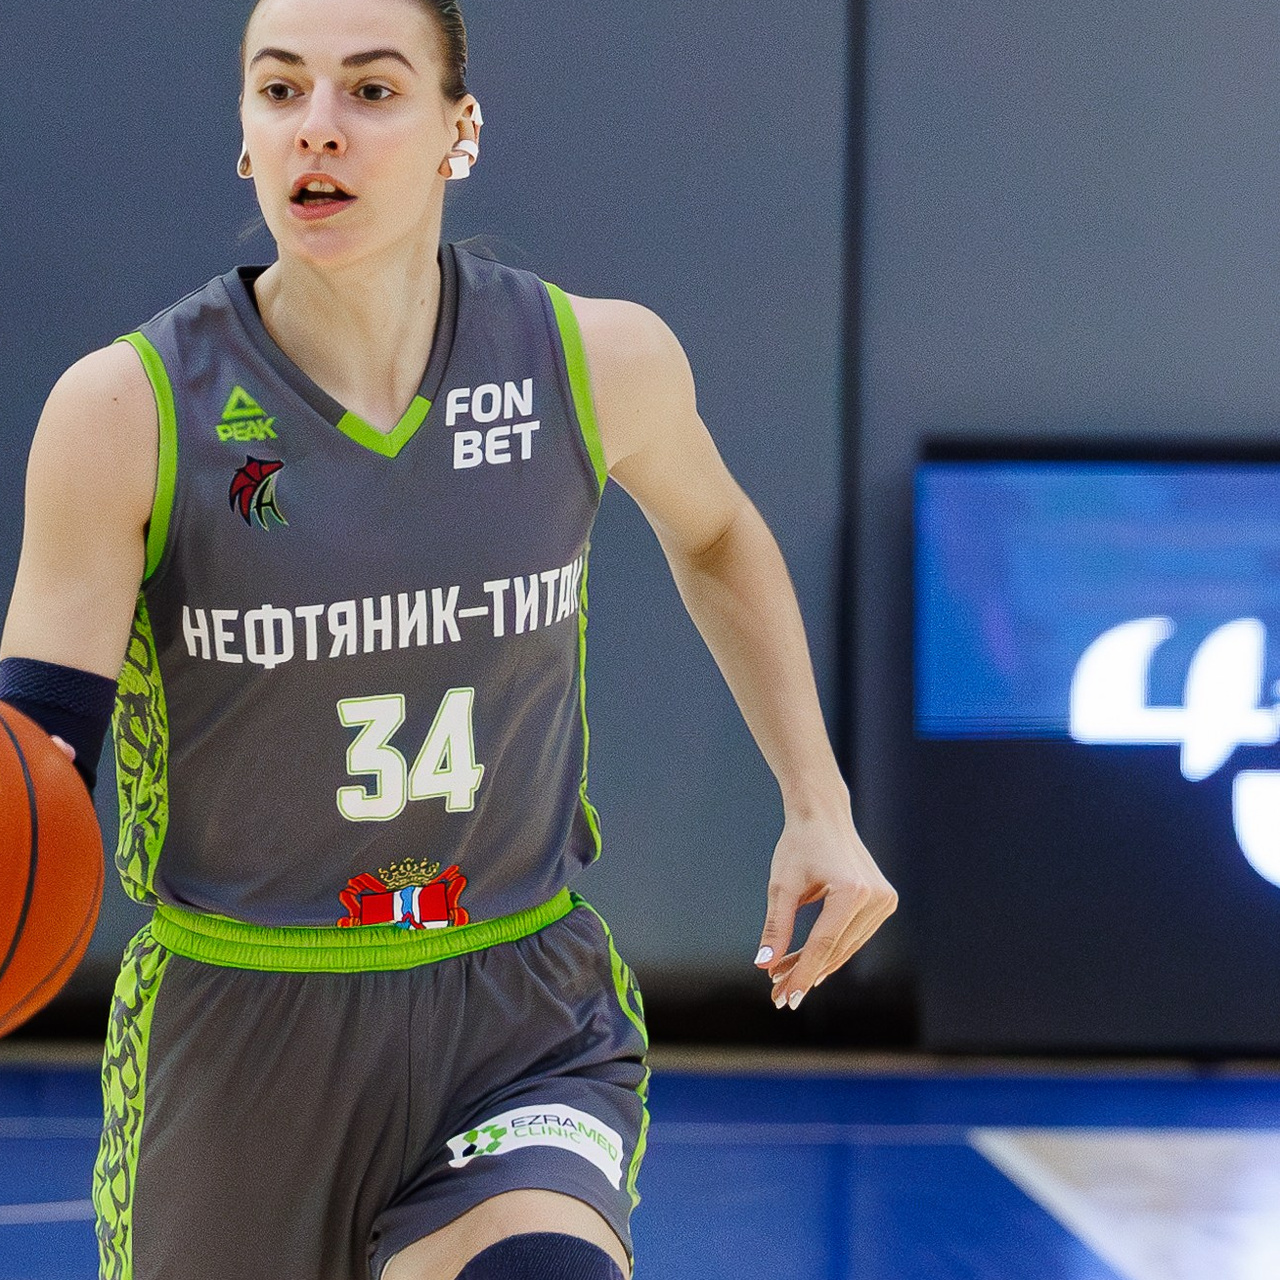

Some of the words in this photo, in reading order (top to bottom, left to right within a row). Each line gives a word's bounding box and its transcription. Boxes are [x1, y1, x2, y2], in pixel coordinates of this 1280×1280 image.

[445, 378, 534, 427] FON
[215, 417, 277, 441] PEAK
[453, 420, 541, 471] BET
[336, 686, 486, 823] 34
[513, 1126, 583, 1145] CLINIC
